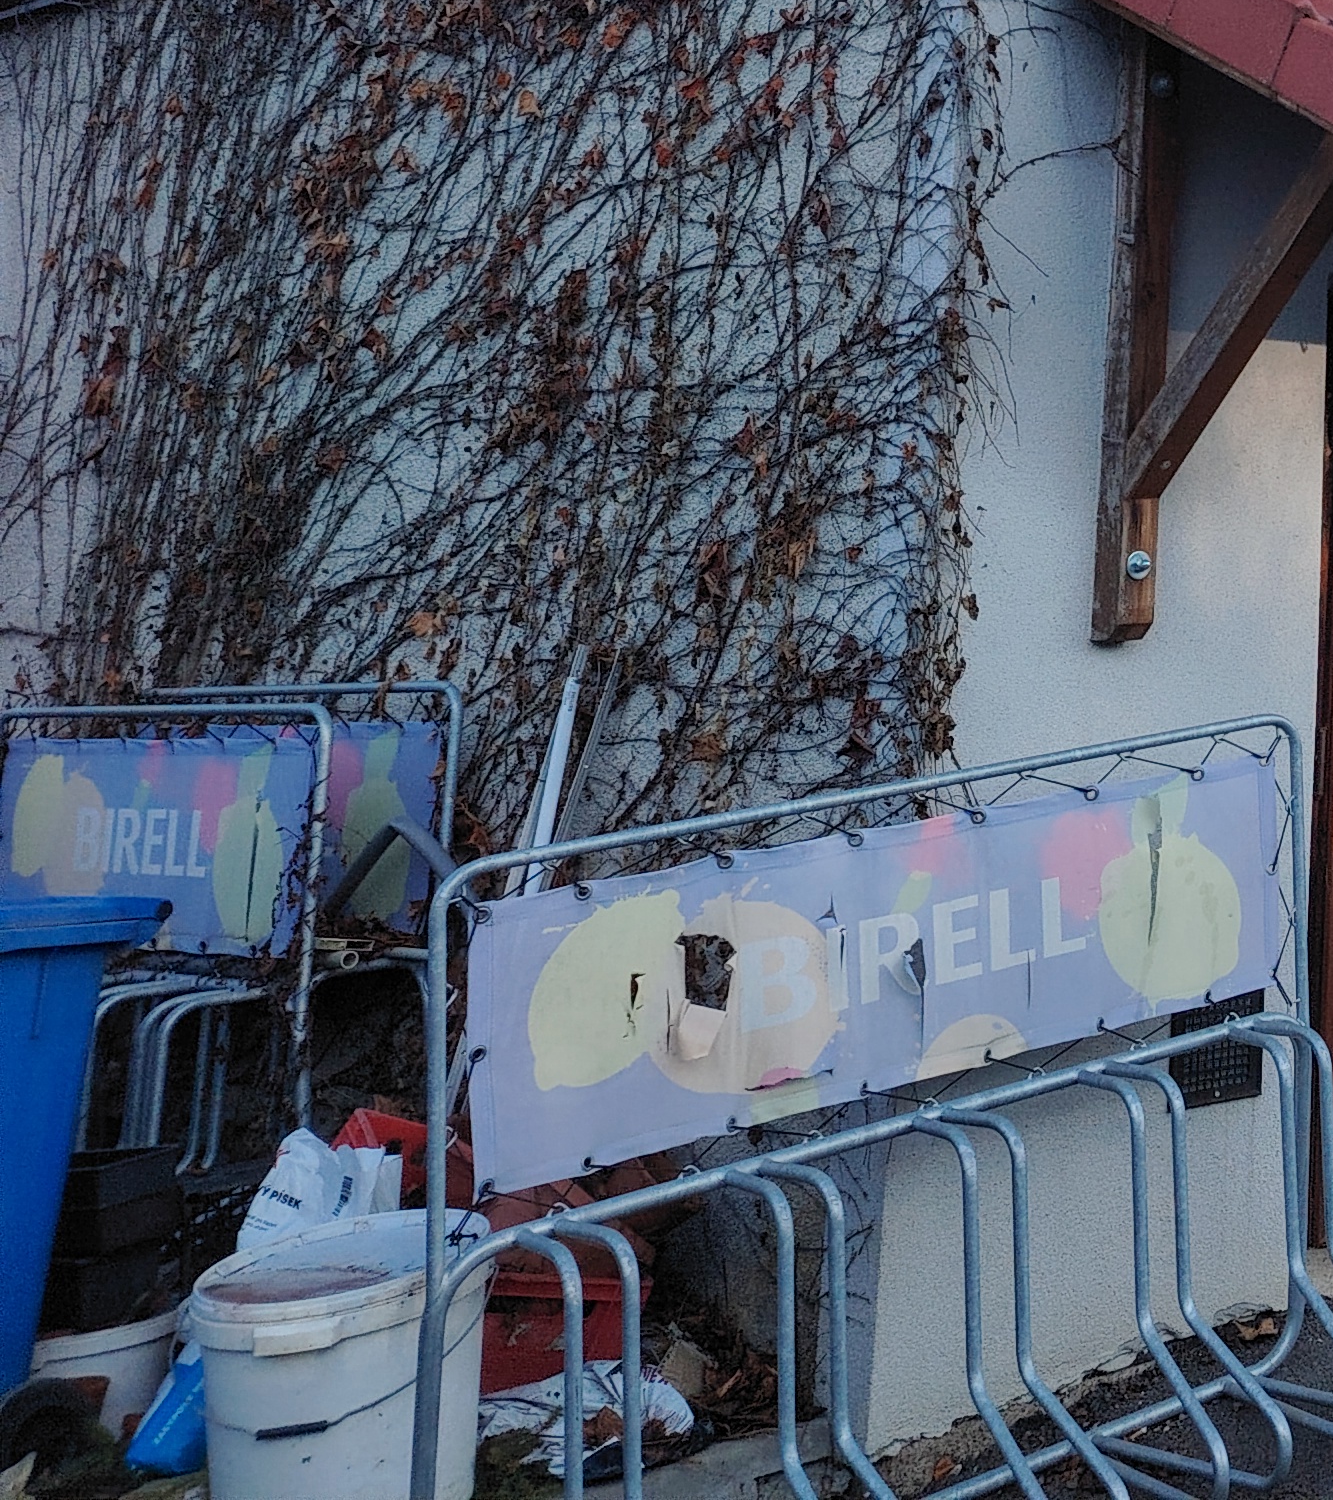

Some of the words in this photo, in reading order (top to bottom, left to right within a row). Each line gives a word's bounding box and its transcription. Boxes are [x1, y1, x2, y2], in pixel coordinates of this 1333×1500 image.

[72, 806, 207, 879] BIRELL
[739, 876, 1087, 1035] BIRELL
[268, 1189, 303, 1211] PÍSEK
